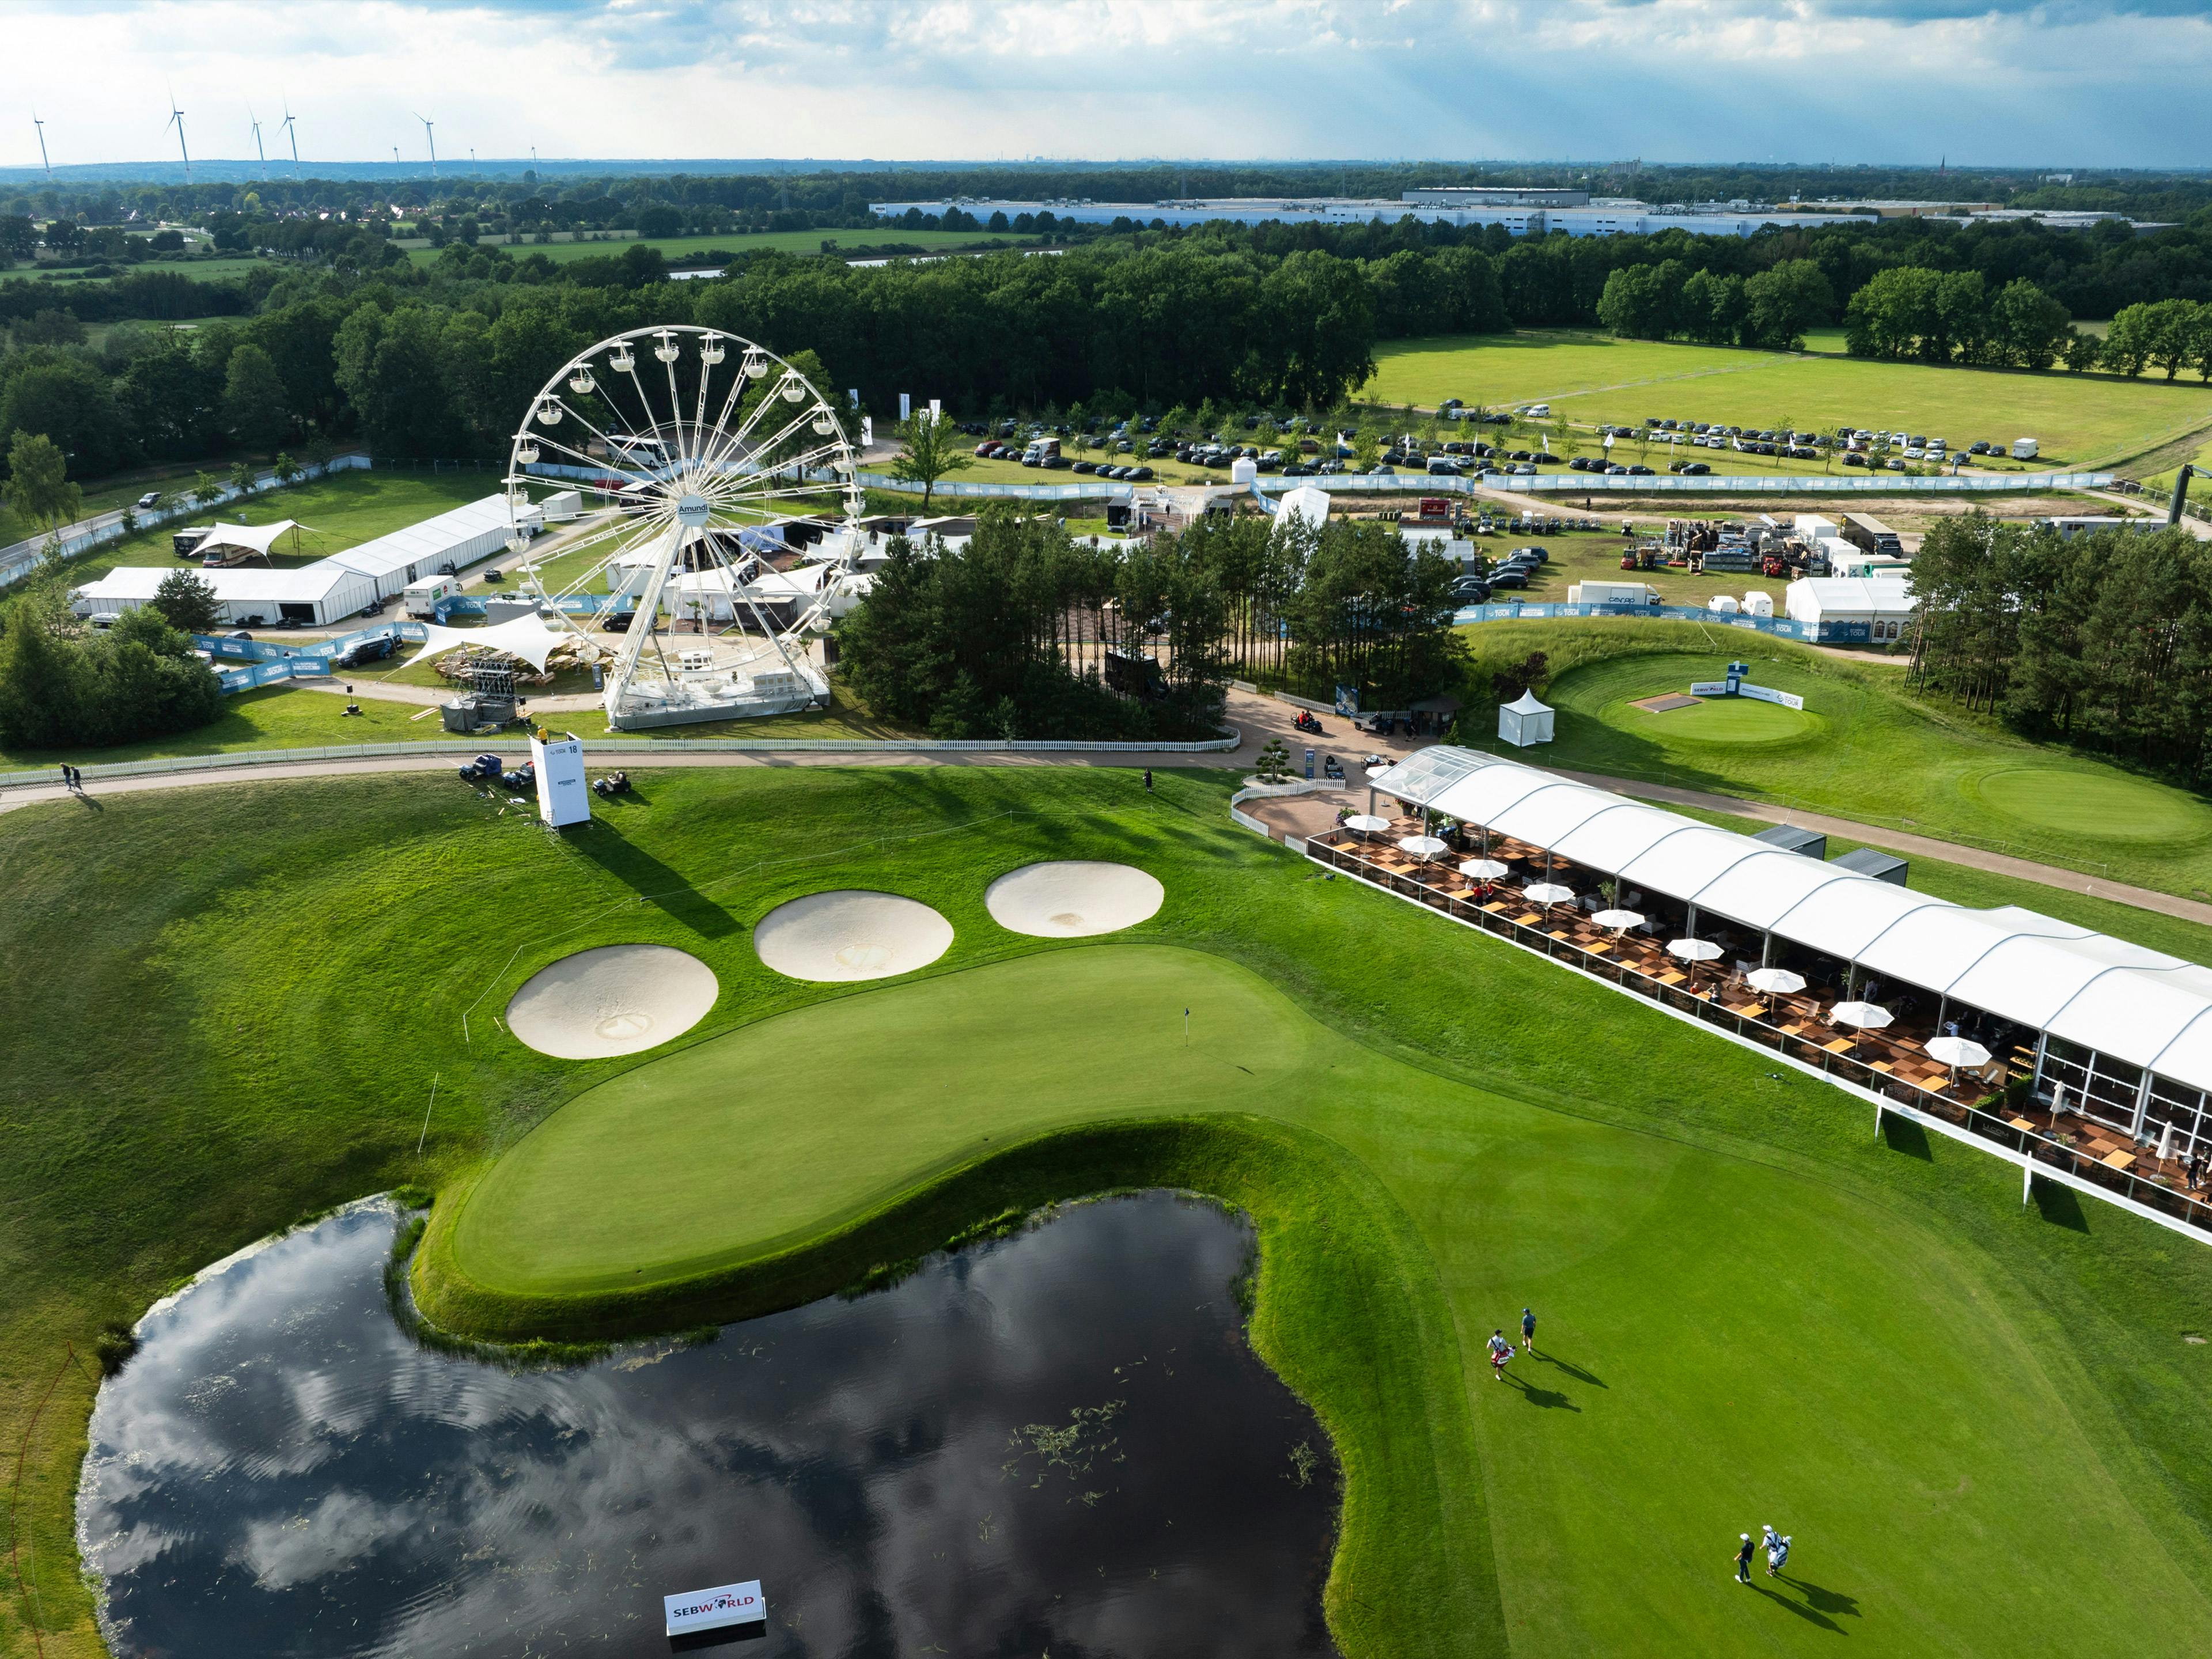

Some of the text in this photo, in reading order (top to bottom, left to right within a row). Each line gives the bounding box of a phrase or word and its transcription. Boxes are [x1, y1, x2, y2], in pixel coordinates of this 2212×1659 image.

[679, 504, 707, 512] Amundi
[1733, 661, 1740, 671] 1
[268, 666, 284, 676] TOUR
[1785, 699, 1798, 707] TOUR
[569, 745, 577, 753] 18
[673, 1596, 754, 1618] SEBWORLD
